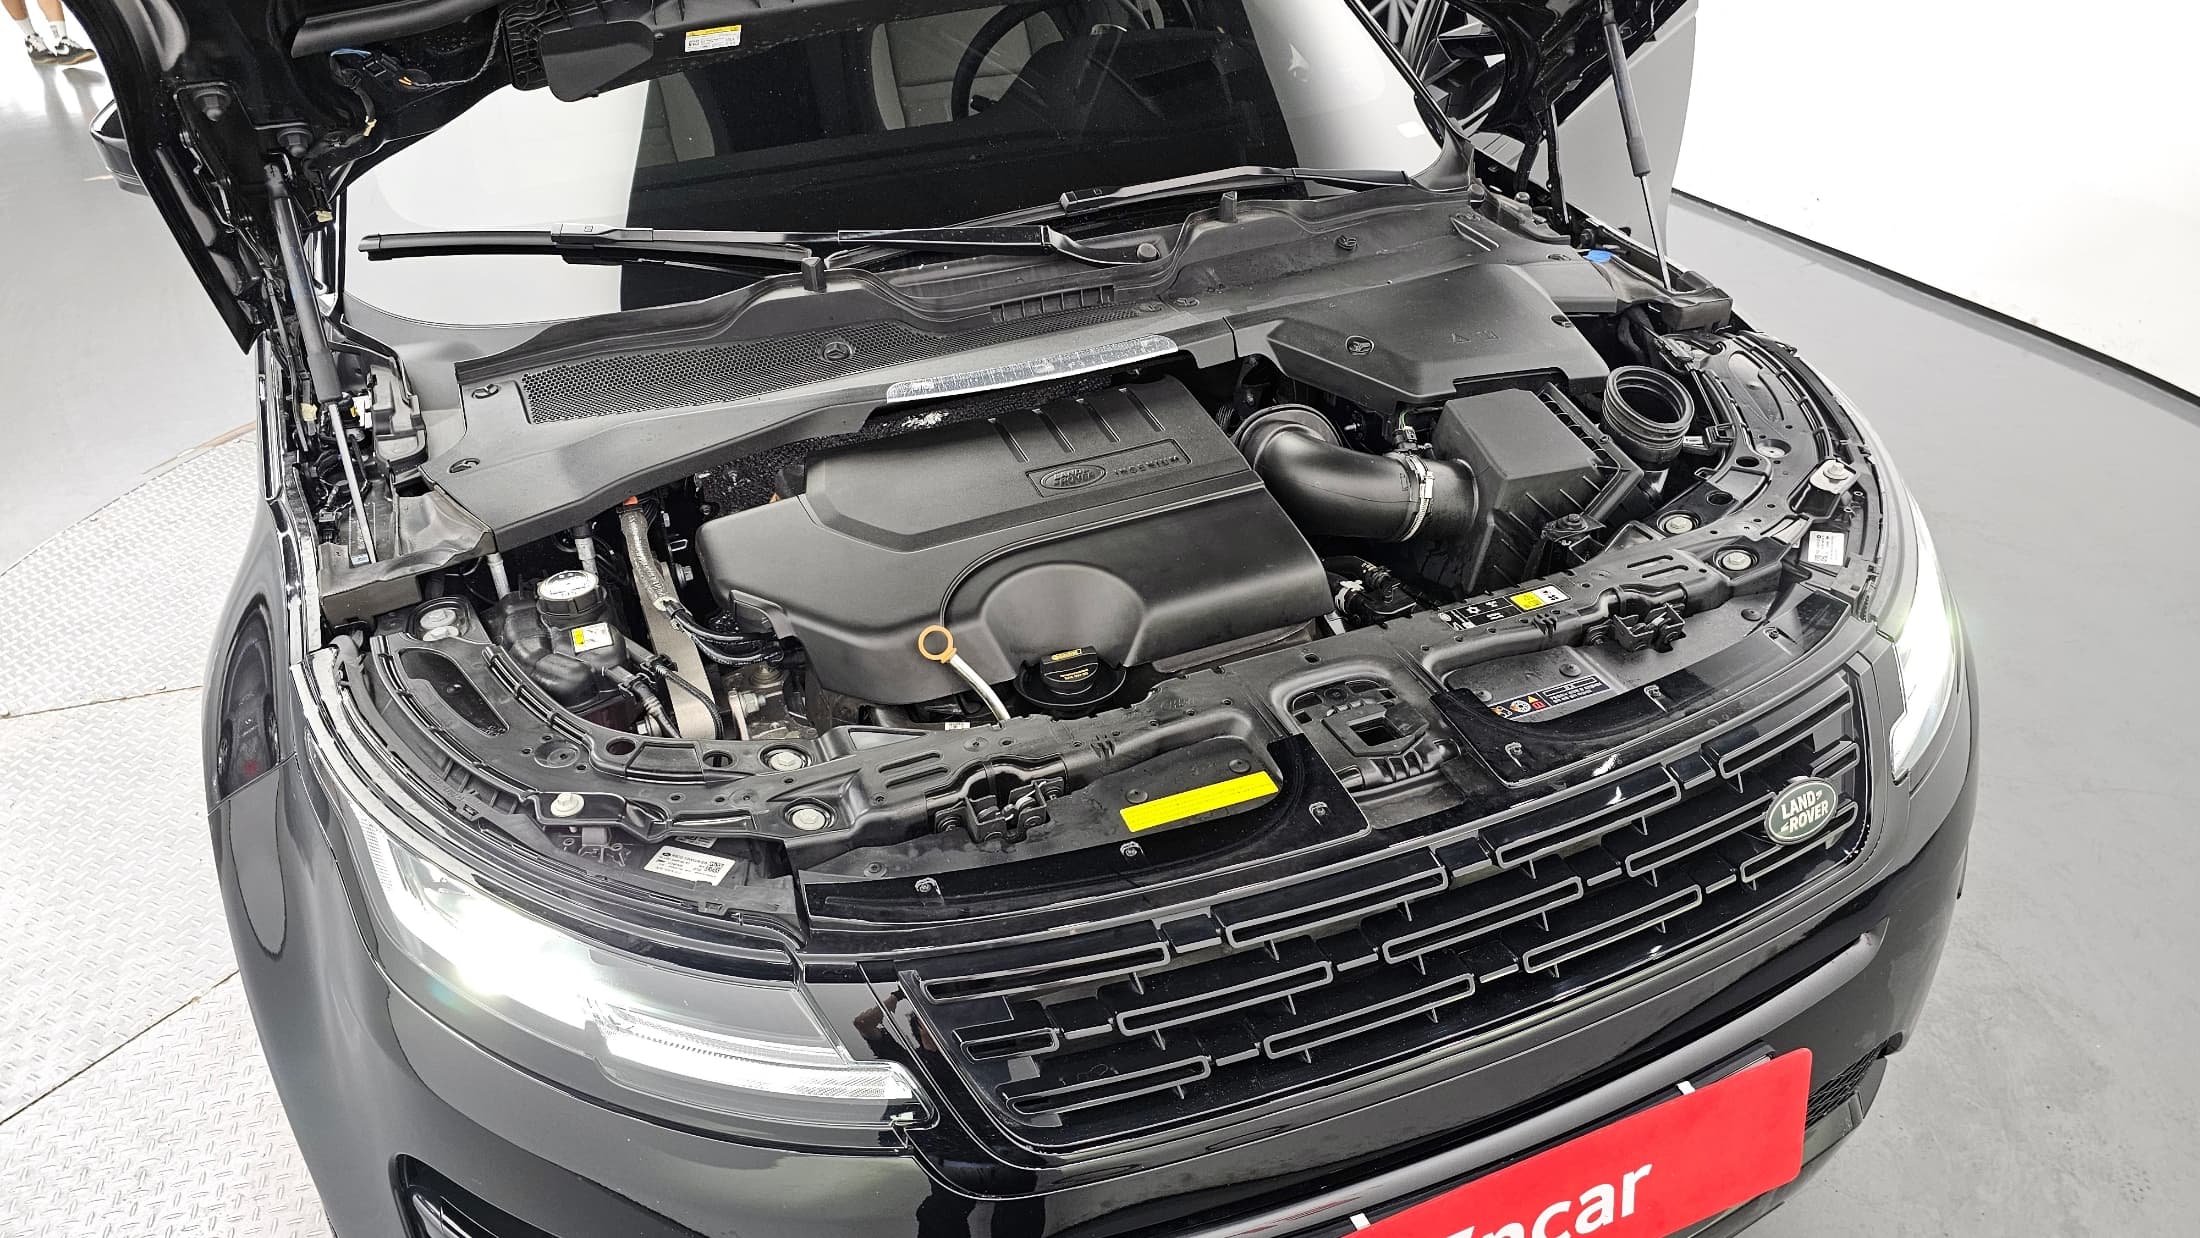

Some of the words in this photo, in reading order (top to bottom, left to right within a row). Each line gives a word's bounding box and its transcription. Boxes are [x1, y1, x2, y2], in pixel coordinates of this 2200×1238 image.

[1781, 790, 1817, 819] LAND
[1789, 800, 1829, 833] ROVER
[1447, 1163, 1653, 1238] car
